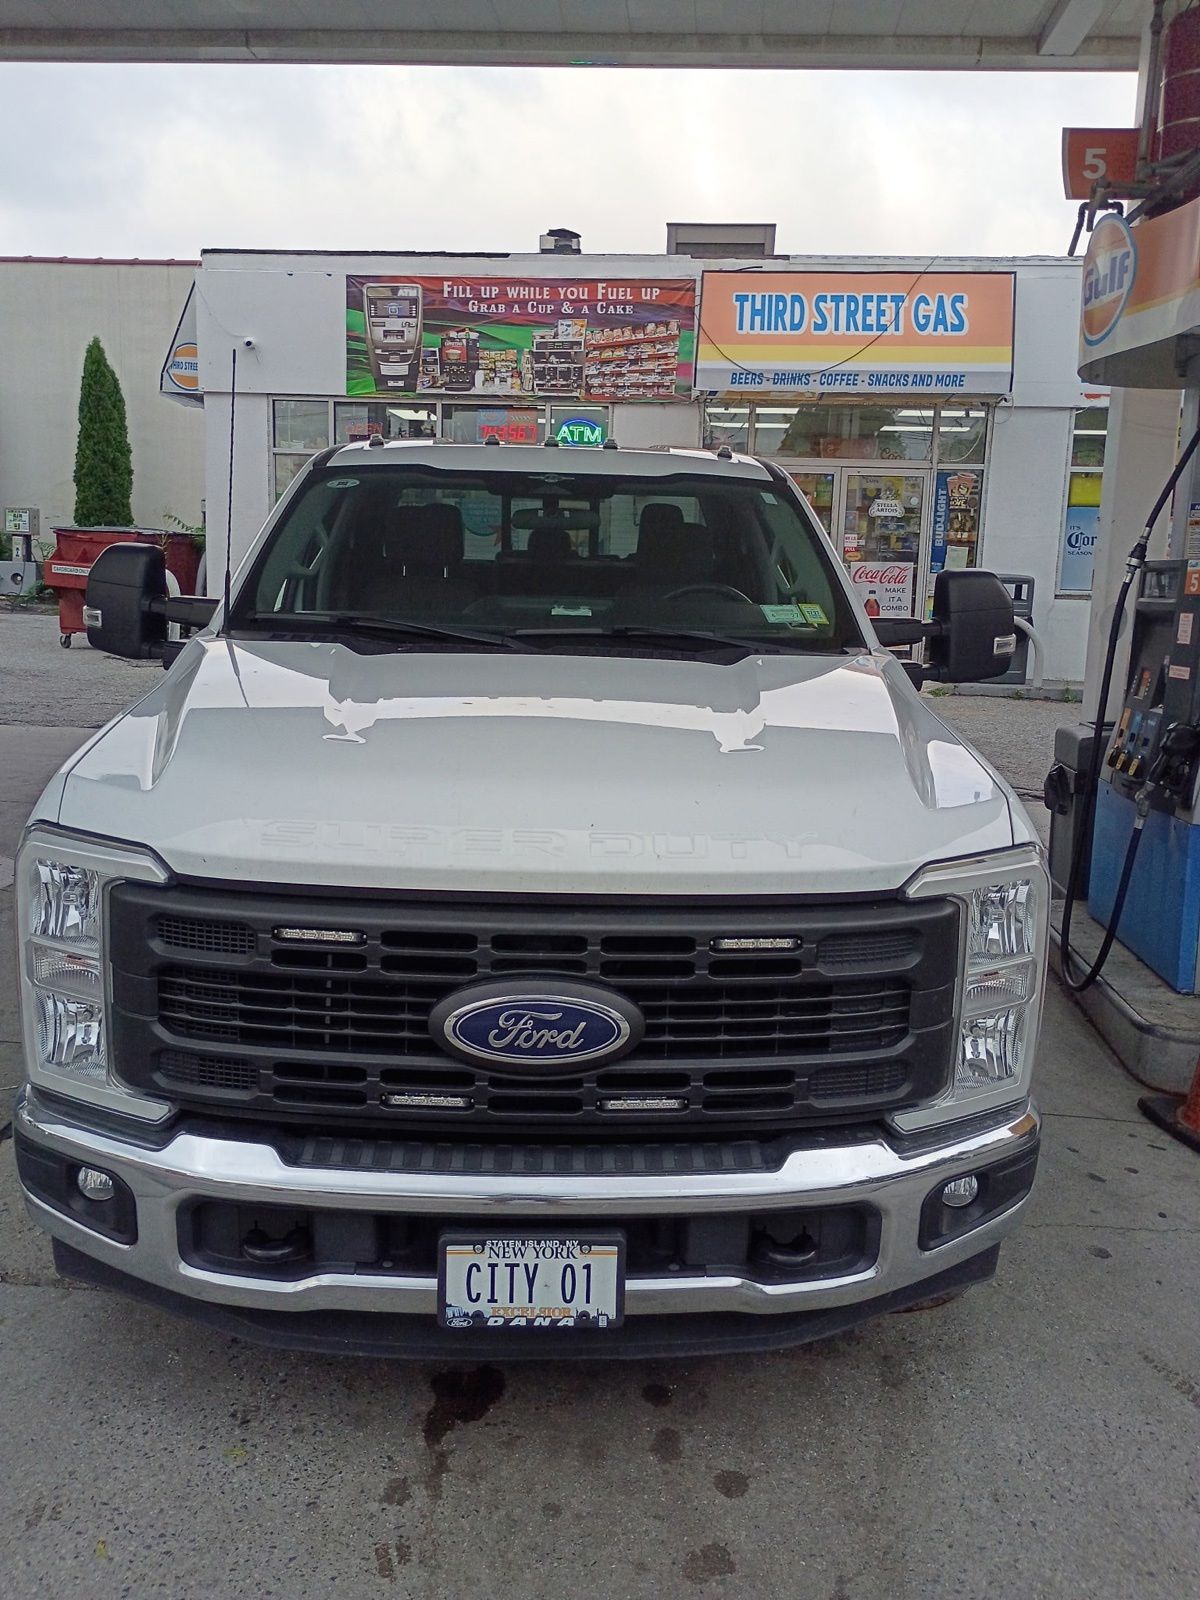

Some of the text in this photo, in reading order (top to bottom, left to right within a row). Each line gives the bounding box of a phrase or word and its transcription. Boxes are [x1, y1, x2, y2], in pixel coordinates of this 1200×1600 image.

[1082, 148, 1107, 180] 5
[1084, 250, 1131, 306] Gulf
[442, 281, 661, 301] FILL UP WHILE YOU FUEL UP
[468, 300, 634, 315] GRAB A CUP & A CAKE
[734, 294, 965, 333] THIRD STREET GAS
[730, 372, 764, 385] BEERS
[772, 373, 811, 386] DRINKS
[819, 373, 859, 386] COFFEE
[867, 374, 910, 387] SNACKS
[910, 375, 934, 387] AND
[935, 375, 966, 388] MORE
[557, 425, 601, 443] ATM
[934, 489, 947, 547] BUD LIGHT
[852, 565, 911, 585] Coca-Cola
[1190, 573, 1199, 592] 5
[261, 820, 817, 860] SUPER DUTY
[488, 1009, 587, 1049] Ford
[486, 1240, 579, 1249] STATEN ISLAND, NY
[488, 1246, 579, 1259] NEW YORK
[466, 1262, 592, 1305] CITY 01
[487, 1316, 575, 1326] DANA
[491, 1307, 572, 1318] EXCELSIOR
